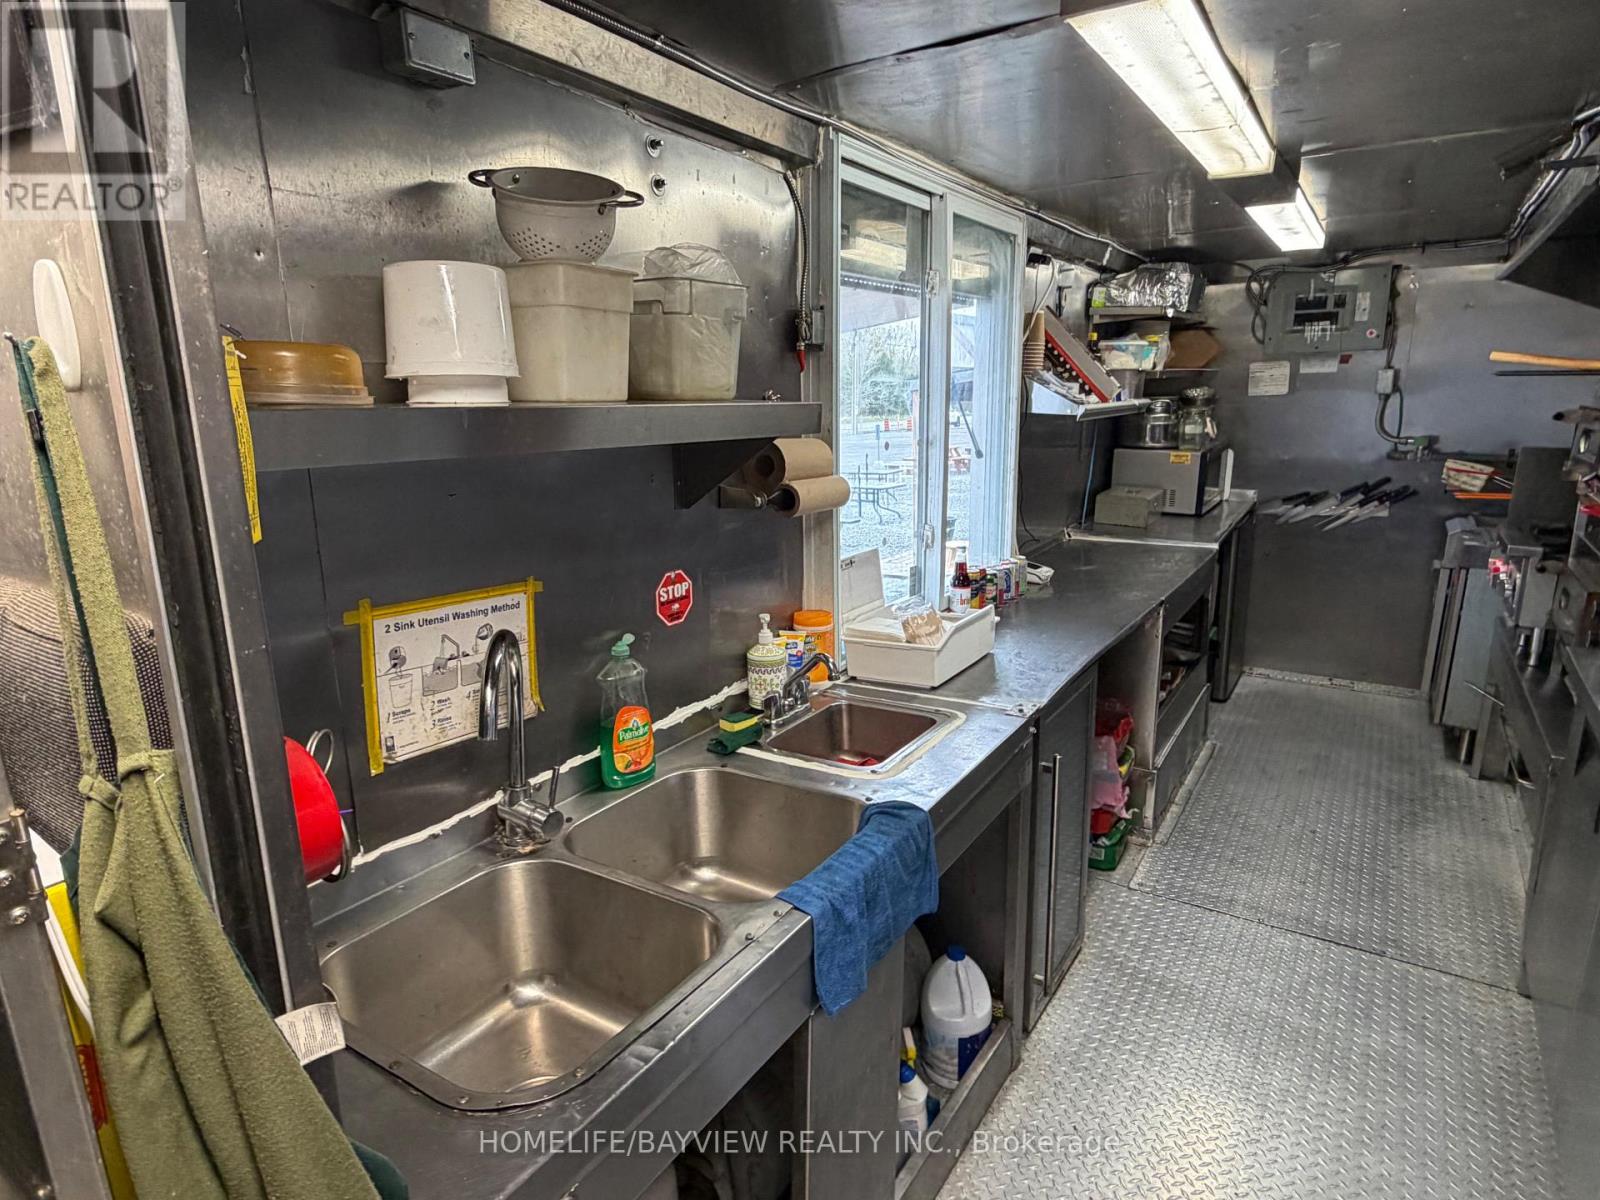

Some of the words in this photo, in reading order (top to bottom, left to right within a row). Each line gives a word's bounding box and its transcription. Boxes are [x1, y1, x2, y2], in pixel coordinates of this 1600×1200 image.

[659, 582, 689, 602] STOP
[384, 624, 391, 634] 2
[393, 621, 416, 633] Sink
[417, 614, 450, 628] Utensil
[452, 607, 489, 621] Washing
[490, 600, 521, 614] Method
